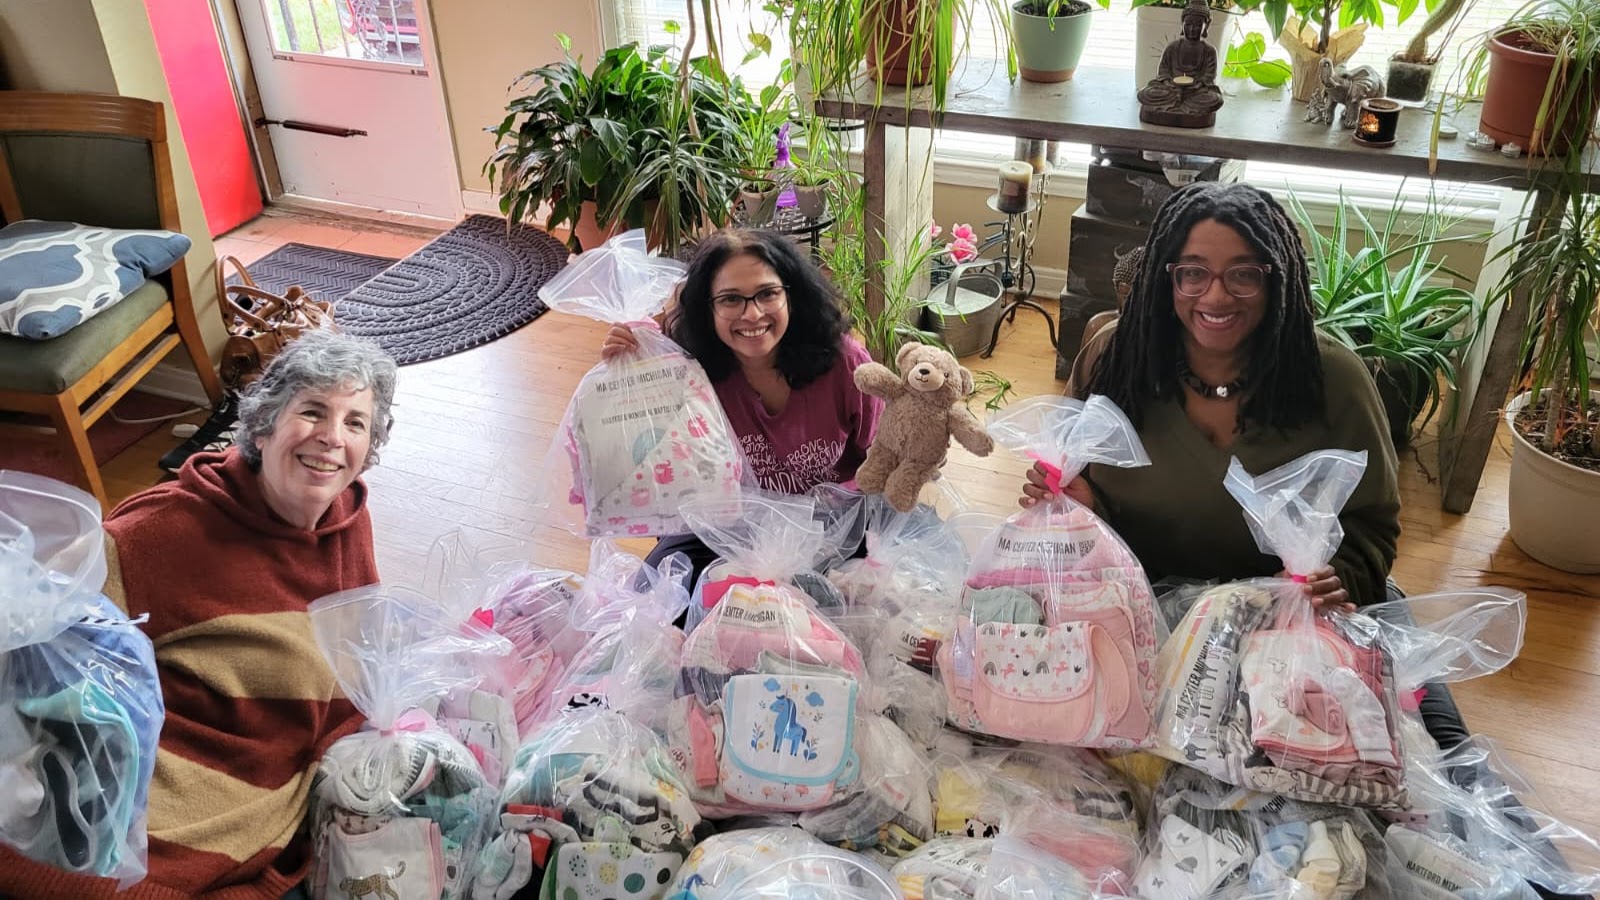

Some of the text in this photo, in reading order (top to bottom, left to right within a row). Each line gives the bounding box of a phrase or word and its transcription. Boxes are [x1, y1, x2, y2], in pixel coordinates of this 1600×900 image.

[595, 382, 608, 393] MA
[636, 367, 673, 384] MICHIGAN
[998, 537, 1011, 550] MA
[1012, 540, 1037, 553] CENTER
[1180, 673, 1202, 705] CENTER
[1406, 860, 1441, 885] HARTFORD
